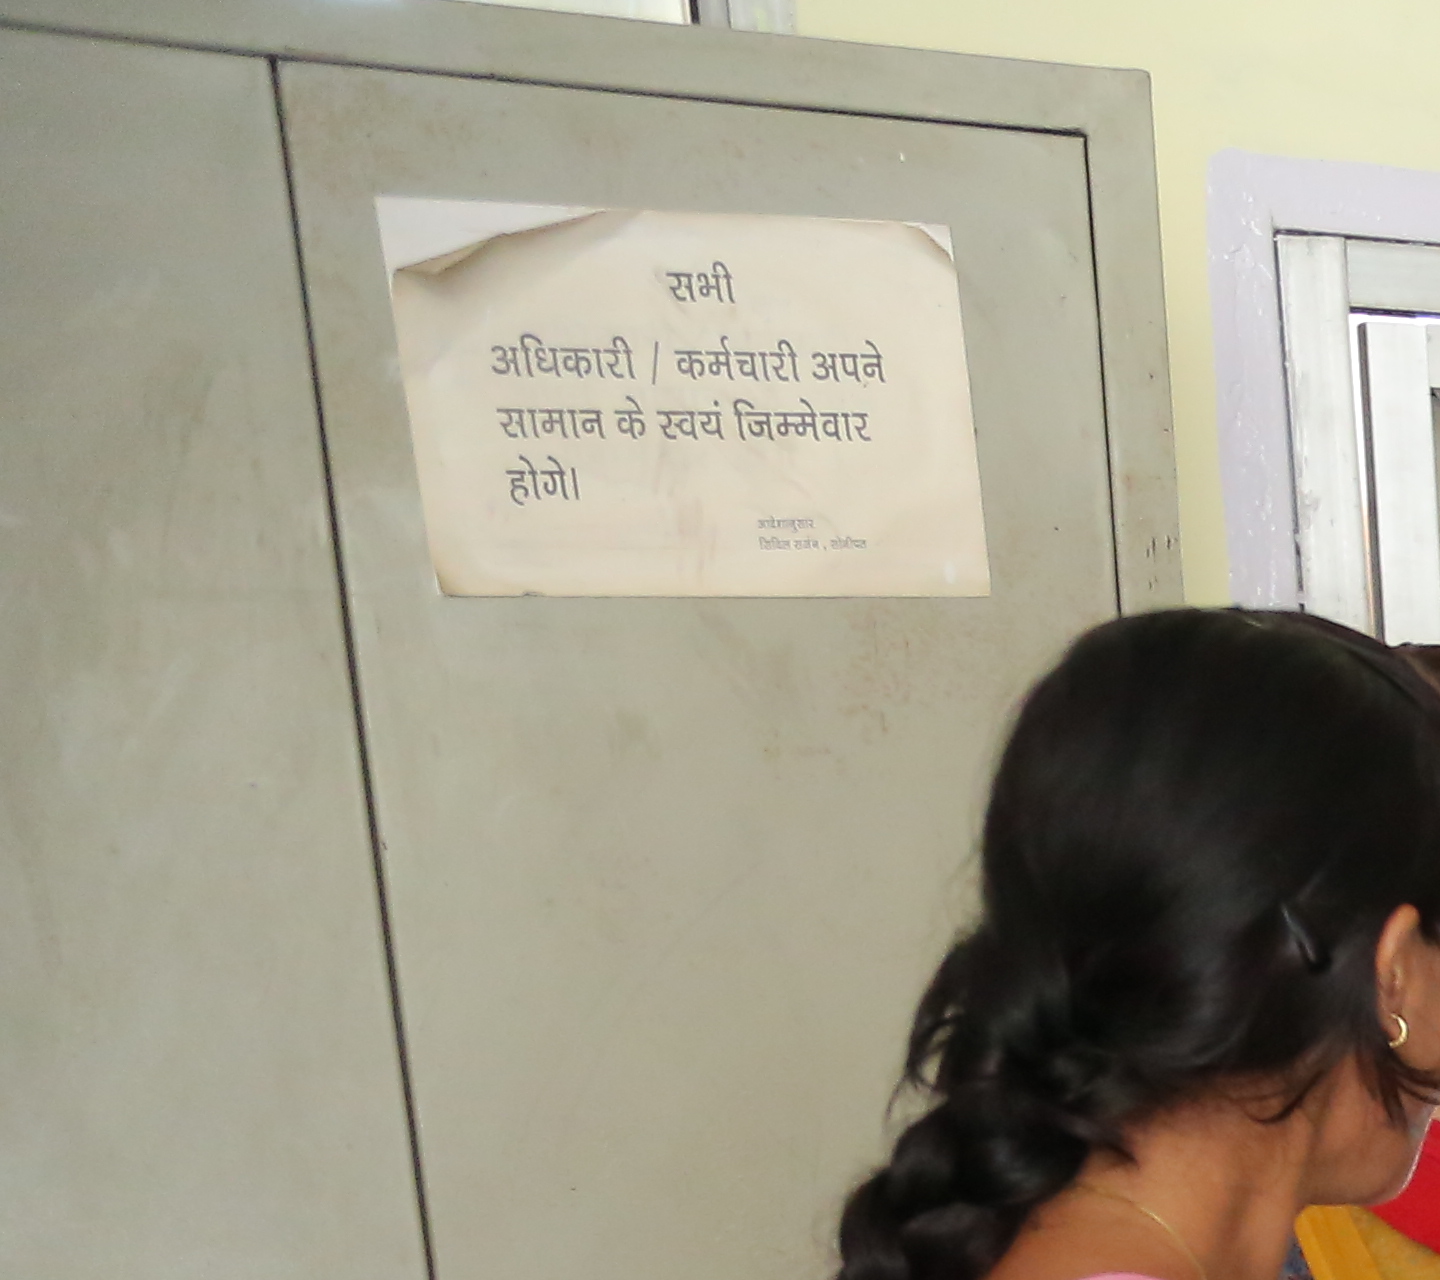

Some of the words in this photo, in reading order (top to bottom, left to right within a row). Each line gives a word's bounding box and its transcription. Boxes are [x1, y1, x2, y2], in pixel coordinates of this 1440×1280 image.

[666, 261, 737, 304] सभी
[491, 333, 637, 381] अधिकारी
[674, 335, 801, 383] कर्मचारी
[811, 339, 887, 384] अपने
[496, 407, 607, 440] सामान
[614, 395, 647, 440] के
[656, 400, 725, 441] स्वयं
[733, 398, 872, 442] जिम्मेवार
